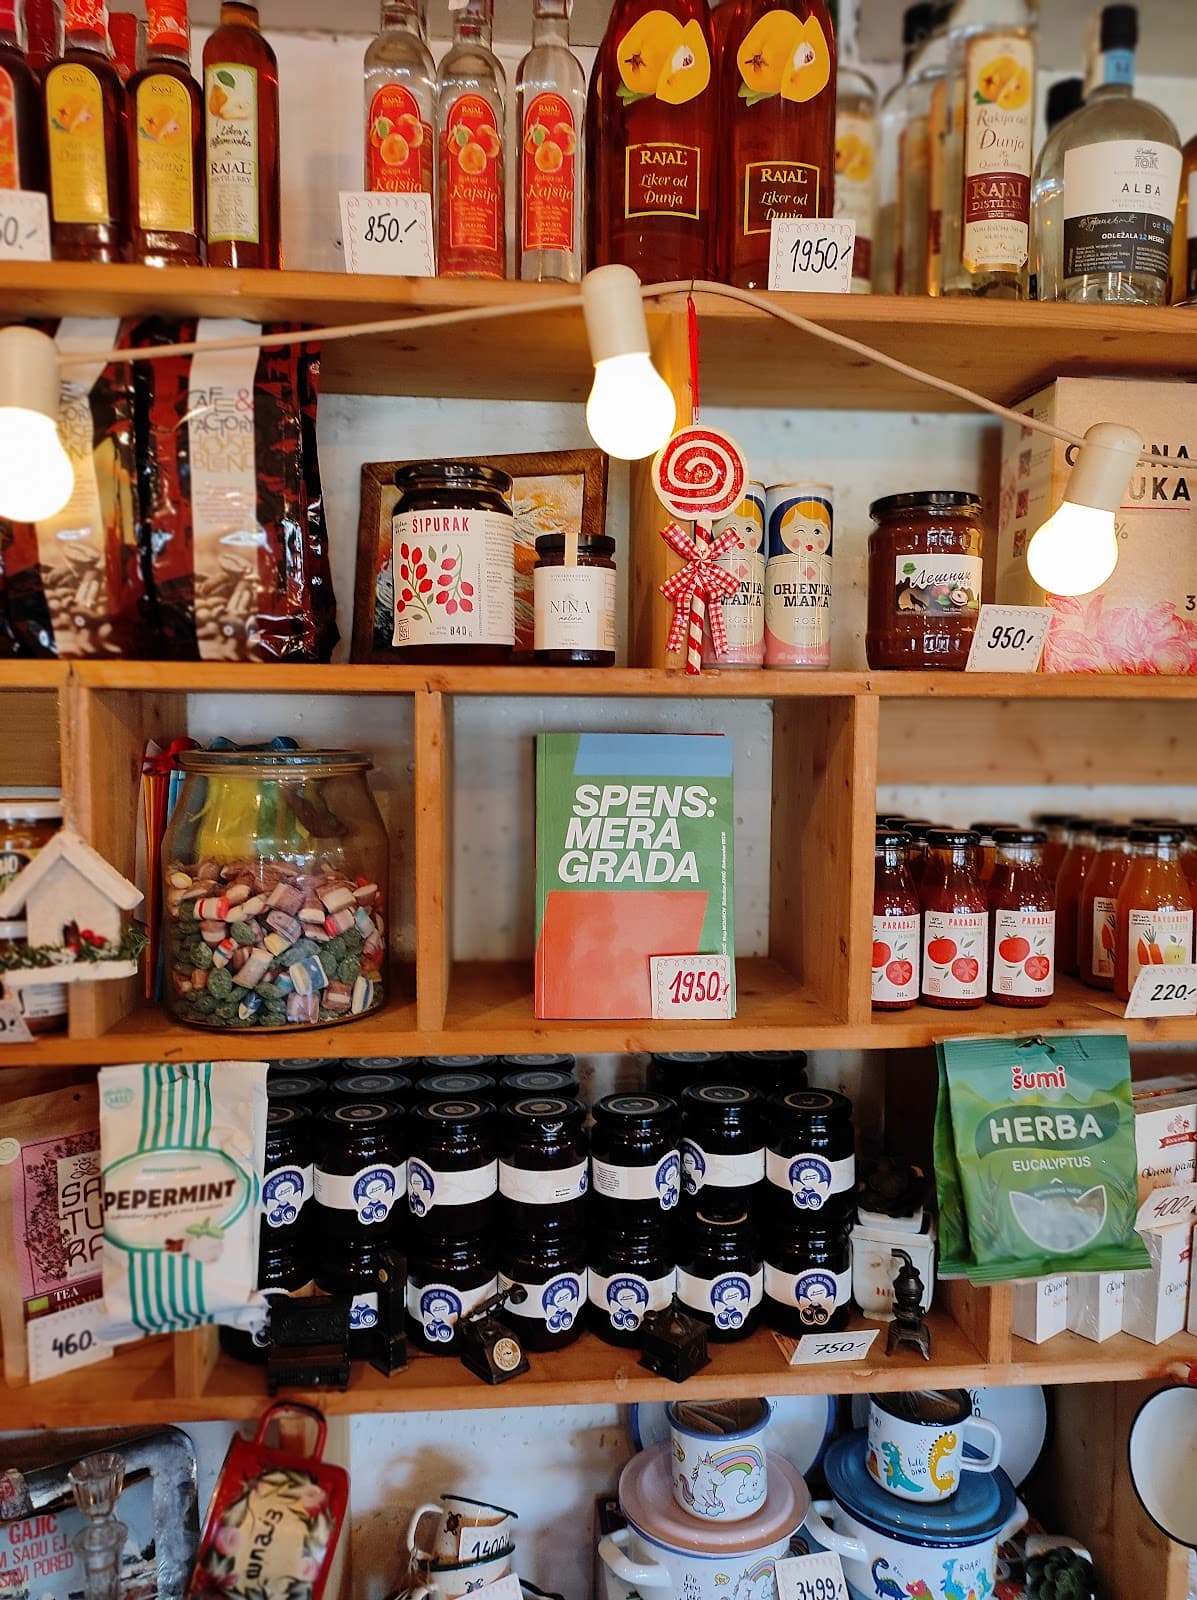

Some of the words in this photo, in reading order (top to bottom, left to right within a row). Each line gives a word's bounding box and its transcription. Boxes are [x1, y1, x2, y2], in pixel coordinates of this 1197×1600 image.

[980, 129, 1025, 153] Dunja
[640, 150, 687, 166] RAJAL
[211, 162, 252, 175] RAJAL
[760, 168, 808, 184] RAJAL
[640, 173, 671, 188] Liker
[672, 174, 689, 189] od
[1121, 183, 1161, 196] ALBA
[643, 190, 684, 207] Dunja
[760, 190, 792, 206] Liker
[792, 192, 808, 206] od
[1101, 232, 1138, 240] ODLEŽALA
[412, 515, 470, 534] ŠIPURAK
[550, 600, 591, 614] NINA
[783, 595, 829, 608] MAMA
[794, 617, 822, 625] ROSE
[572, 784, 718, 819] SPENS:
[564, 817, 681, 850] MERA
[557, 850, 701, 884] GRADA
[1012, 1066, 1066, 1090] šumi
[989, 1113, 1104, 1144] HERBA
[1012, 1156, 1092, 1172] EUCALYPTUS
[104, 1179, 236, 1211] PEPERMINT
[53, 1287, 79, 1302] TEA
